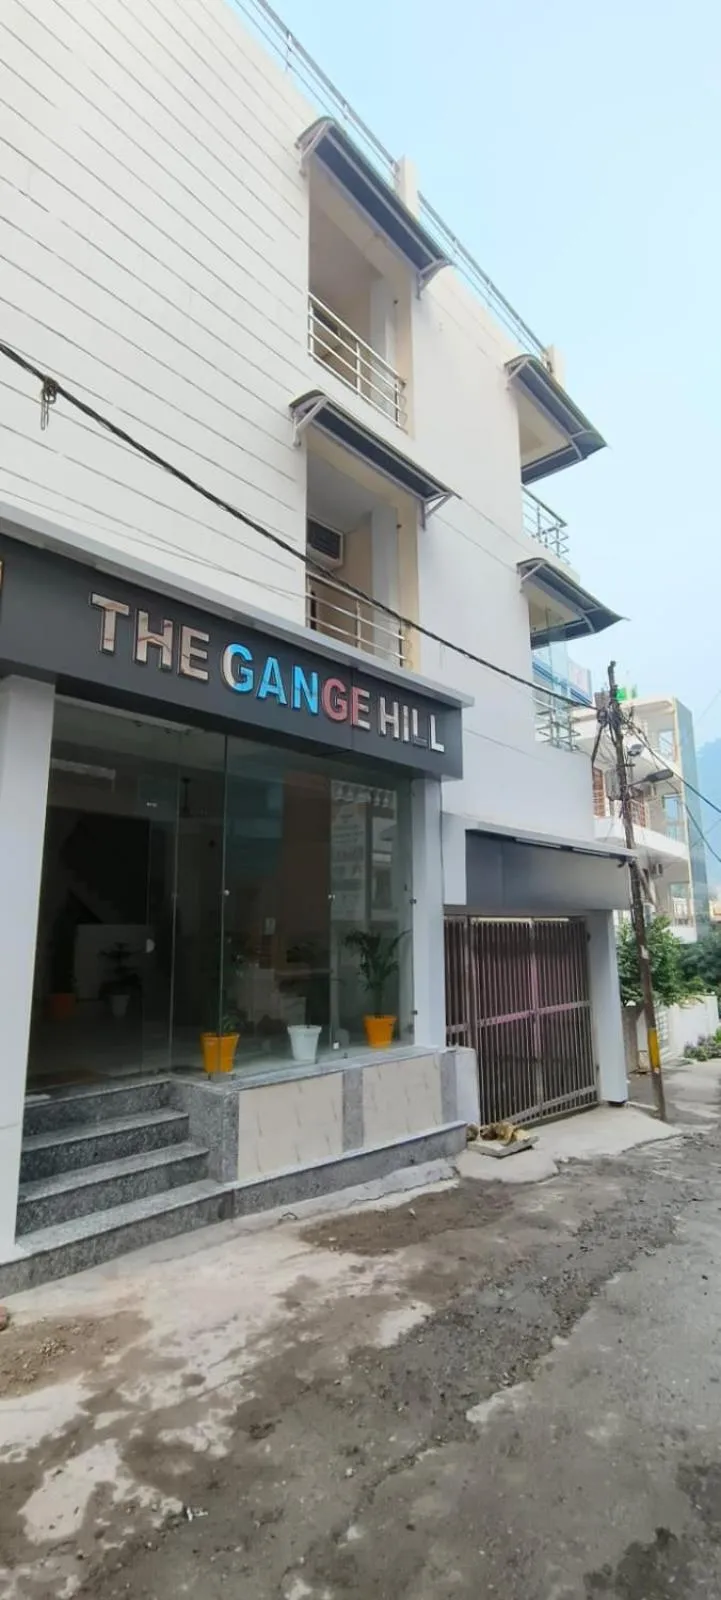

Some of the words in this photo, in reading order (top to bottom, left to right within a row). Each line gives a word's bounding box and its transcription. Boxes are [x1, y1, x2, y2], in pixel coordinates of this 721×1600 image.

[89, 593, 209, 681] THE
[221, 643, 371, 731] GANGE
[378, 696, 446, 752] HILL
